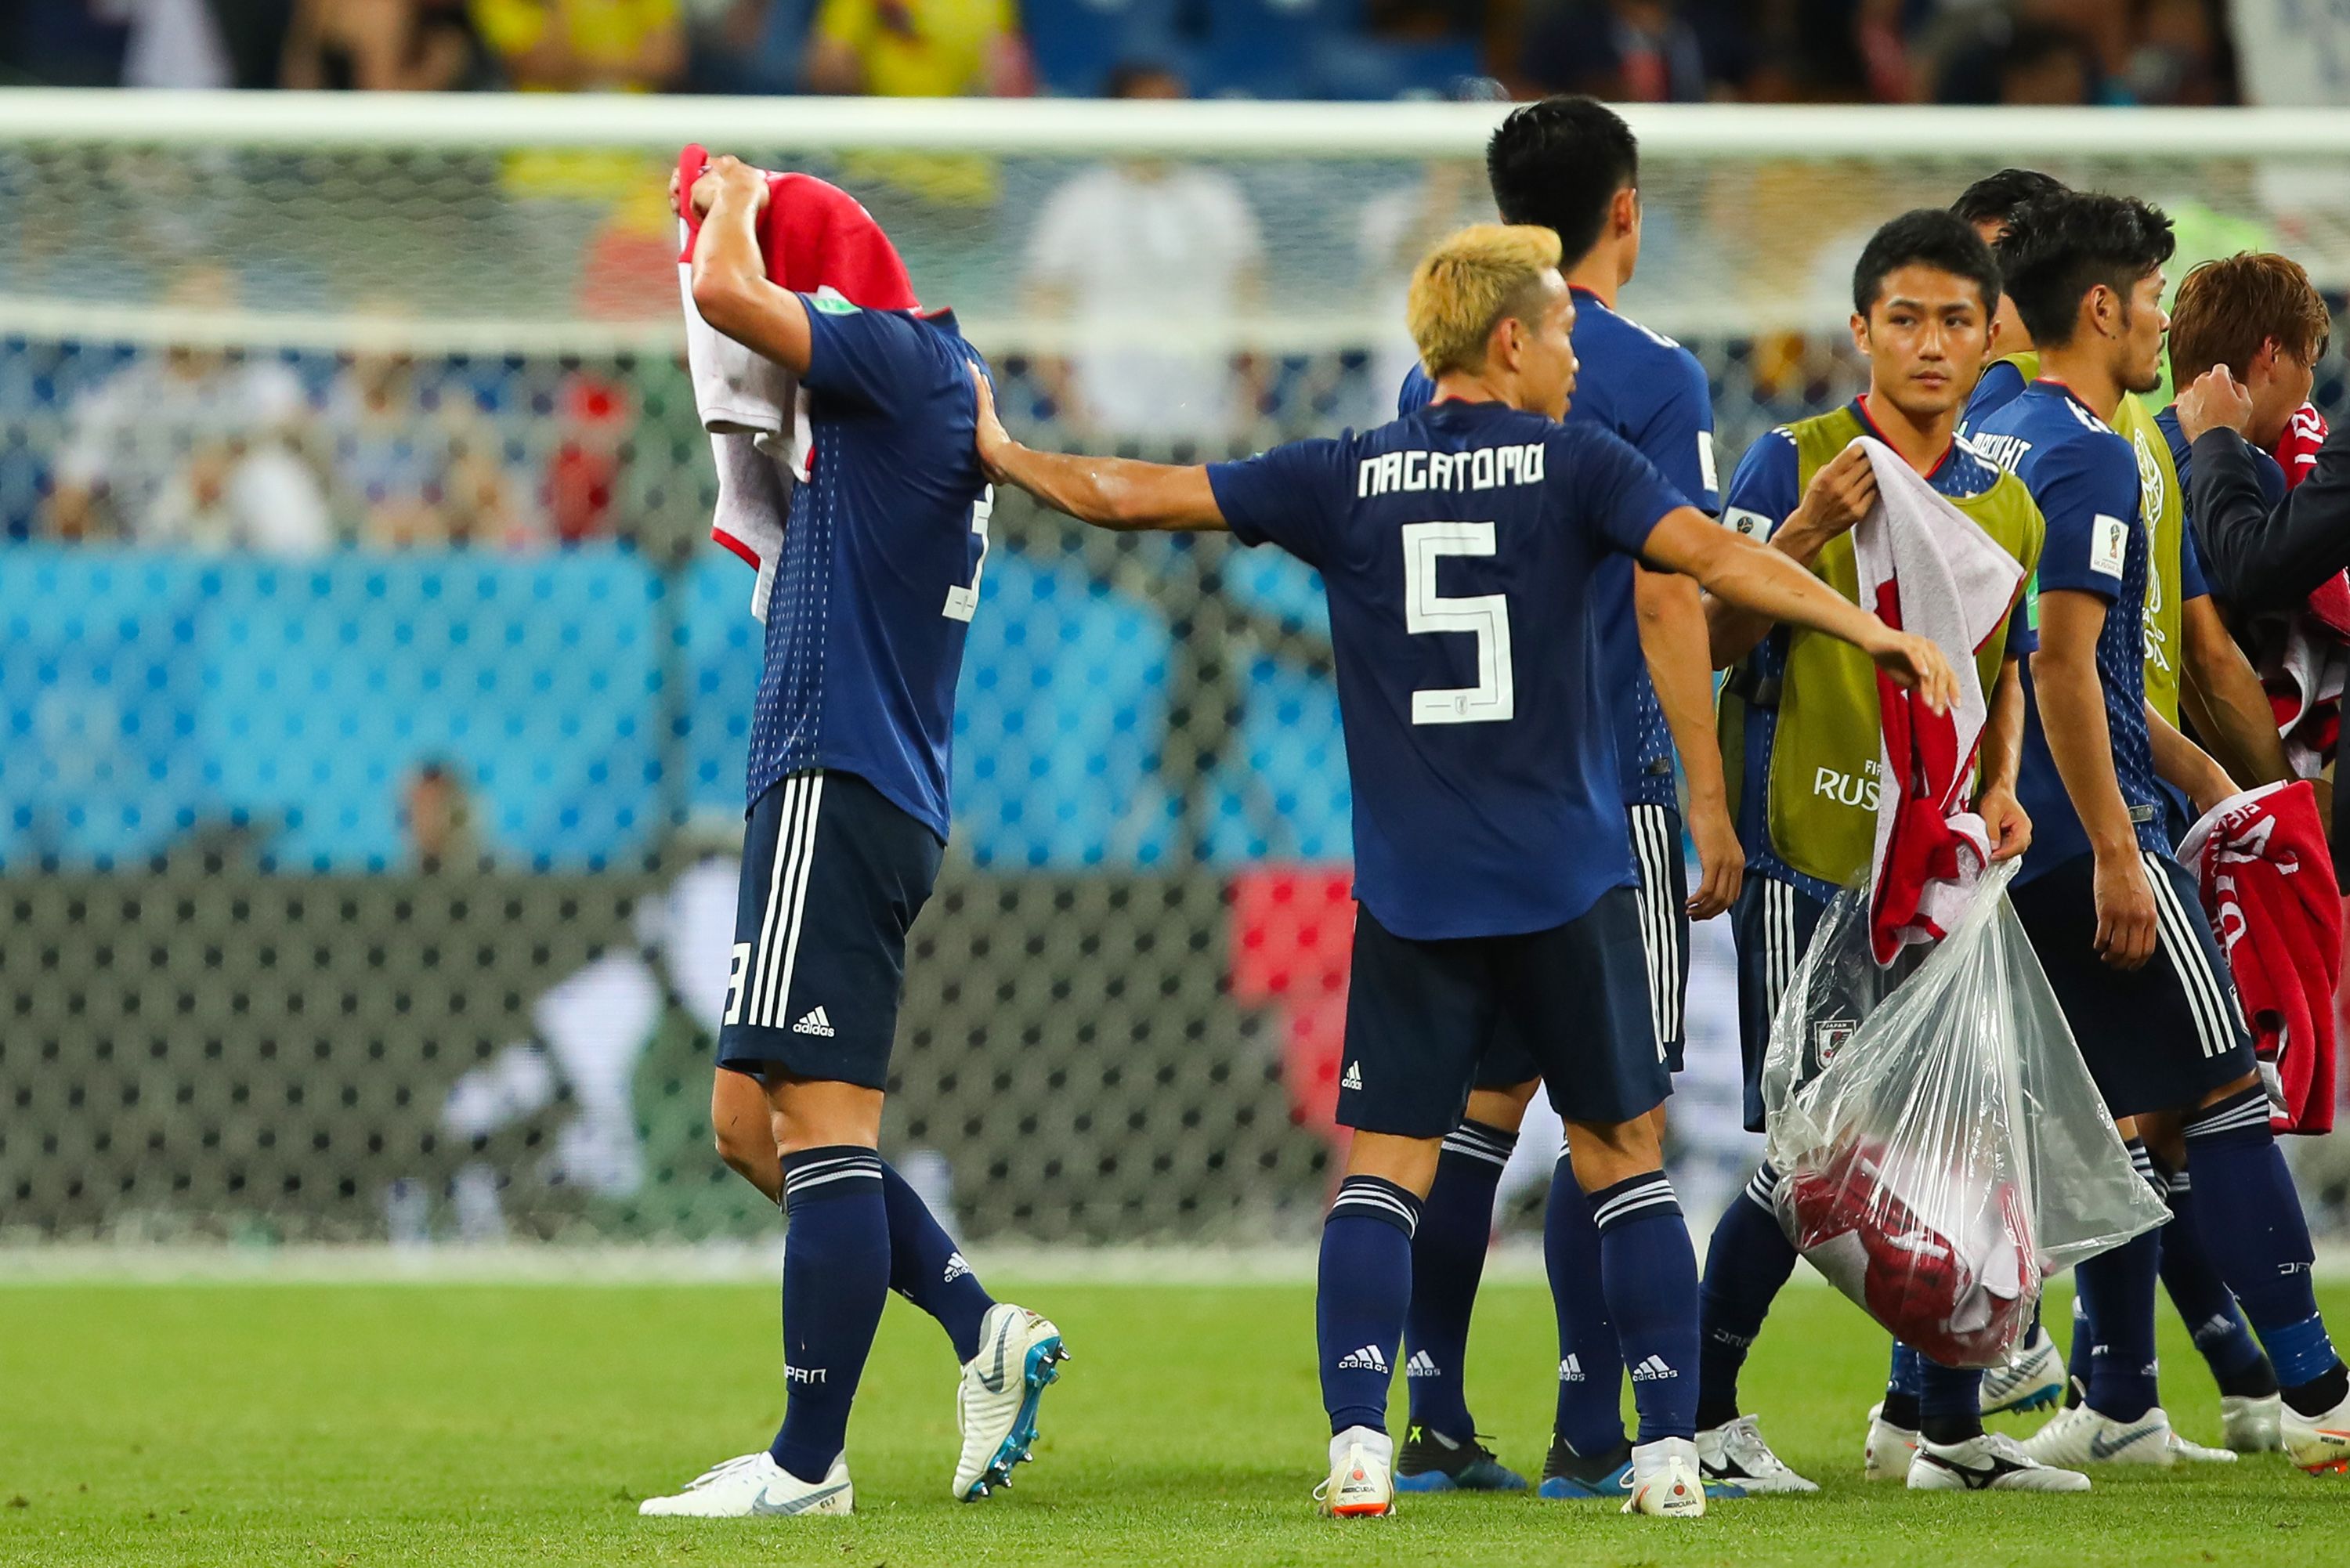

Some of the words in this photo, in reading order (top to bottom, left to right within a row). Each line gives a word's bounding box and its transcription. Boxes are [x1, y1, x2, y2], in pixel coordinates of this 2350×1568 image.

[1358, 443, 1545, 497] NAGATOMO
[1402, 522, 1513, 724] 5
[1865, 760, 1882, 776] FIF
[1814, 767, 1880, 811] RUS
[793, 1023, 835, 1038] adidas
[784, 1364, 826, 1384] PAN
[1339, 1359, 1388, 1374] adidas
[1632, 1370, 1678, 1382] adidas
